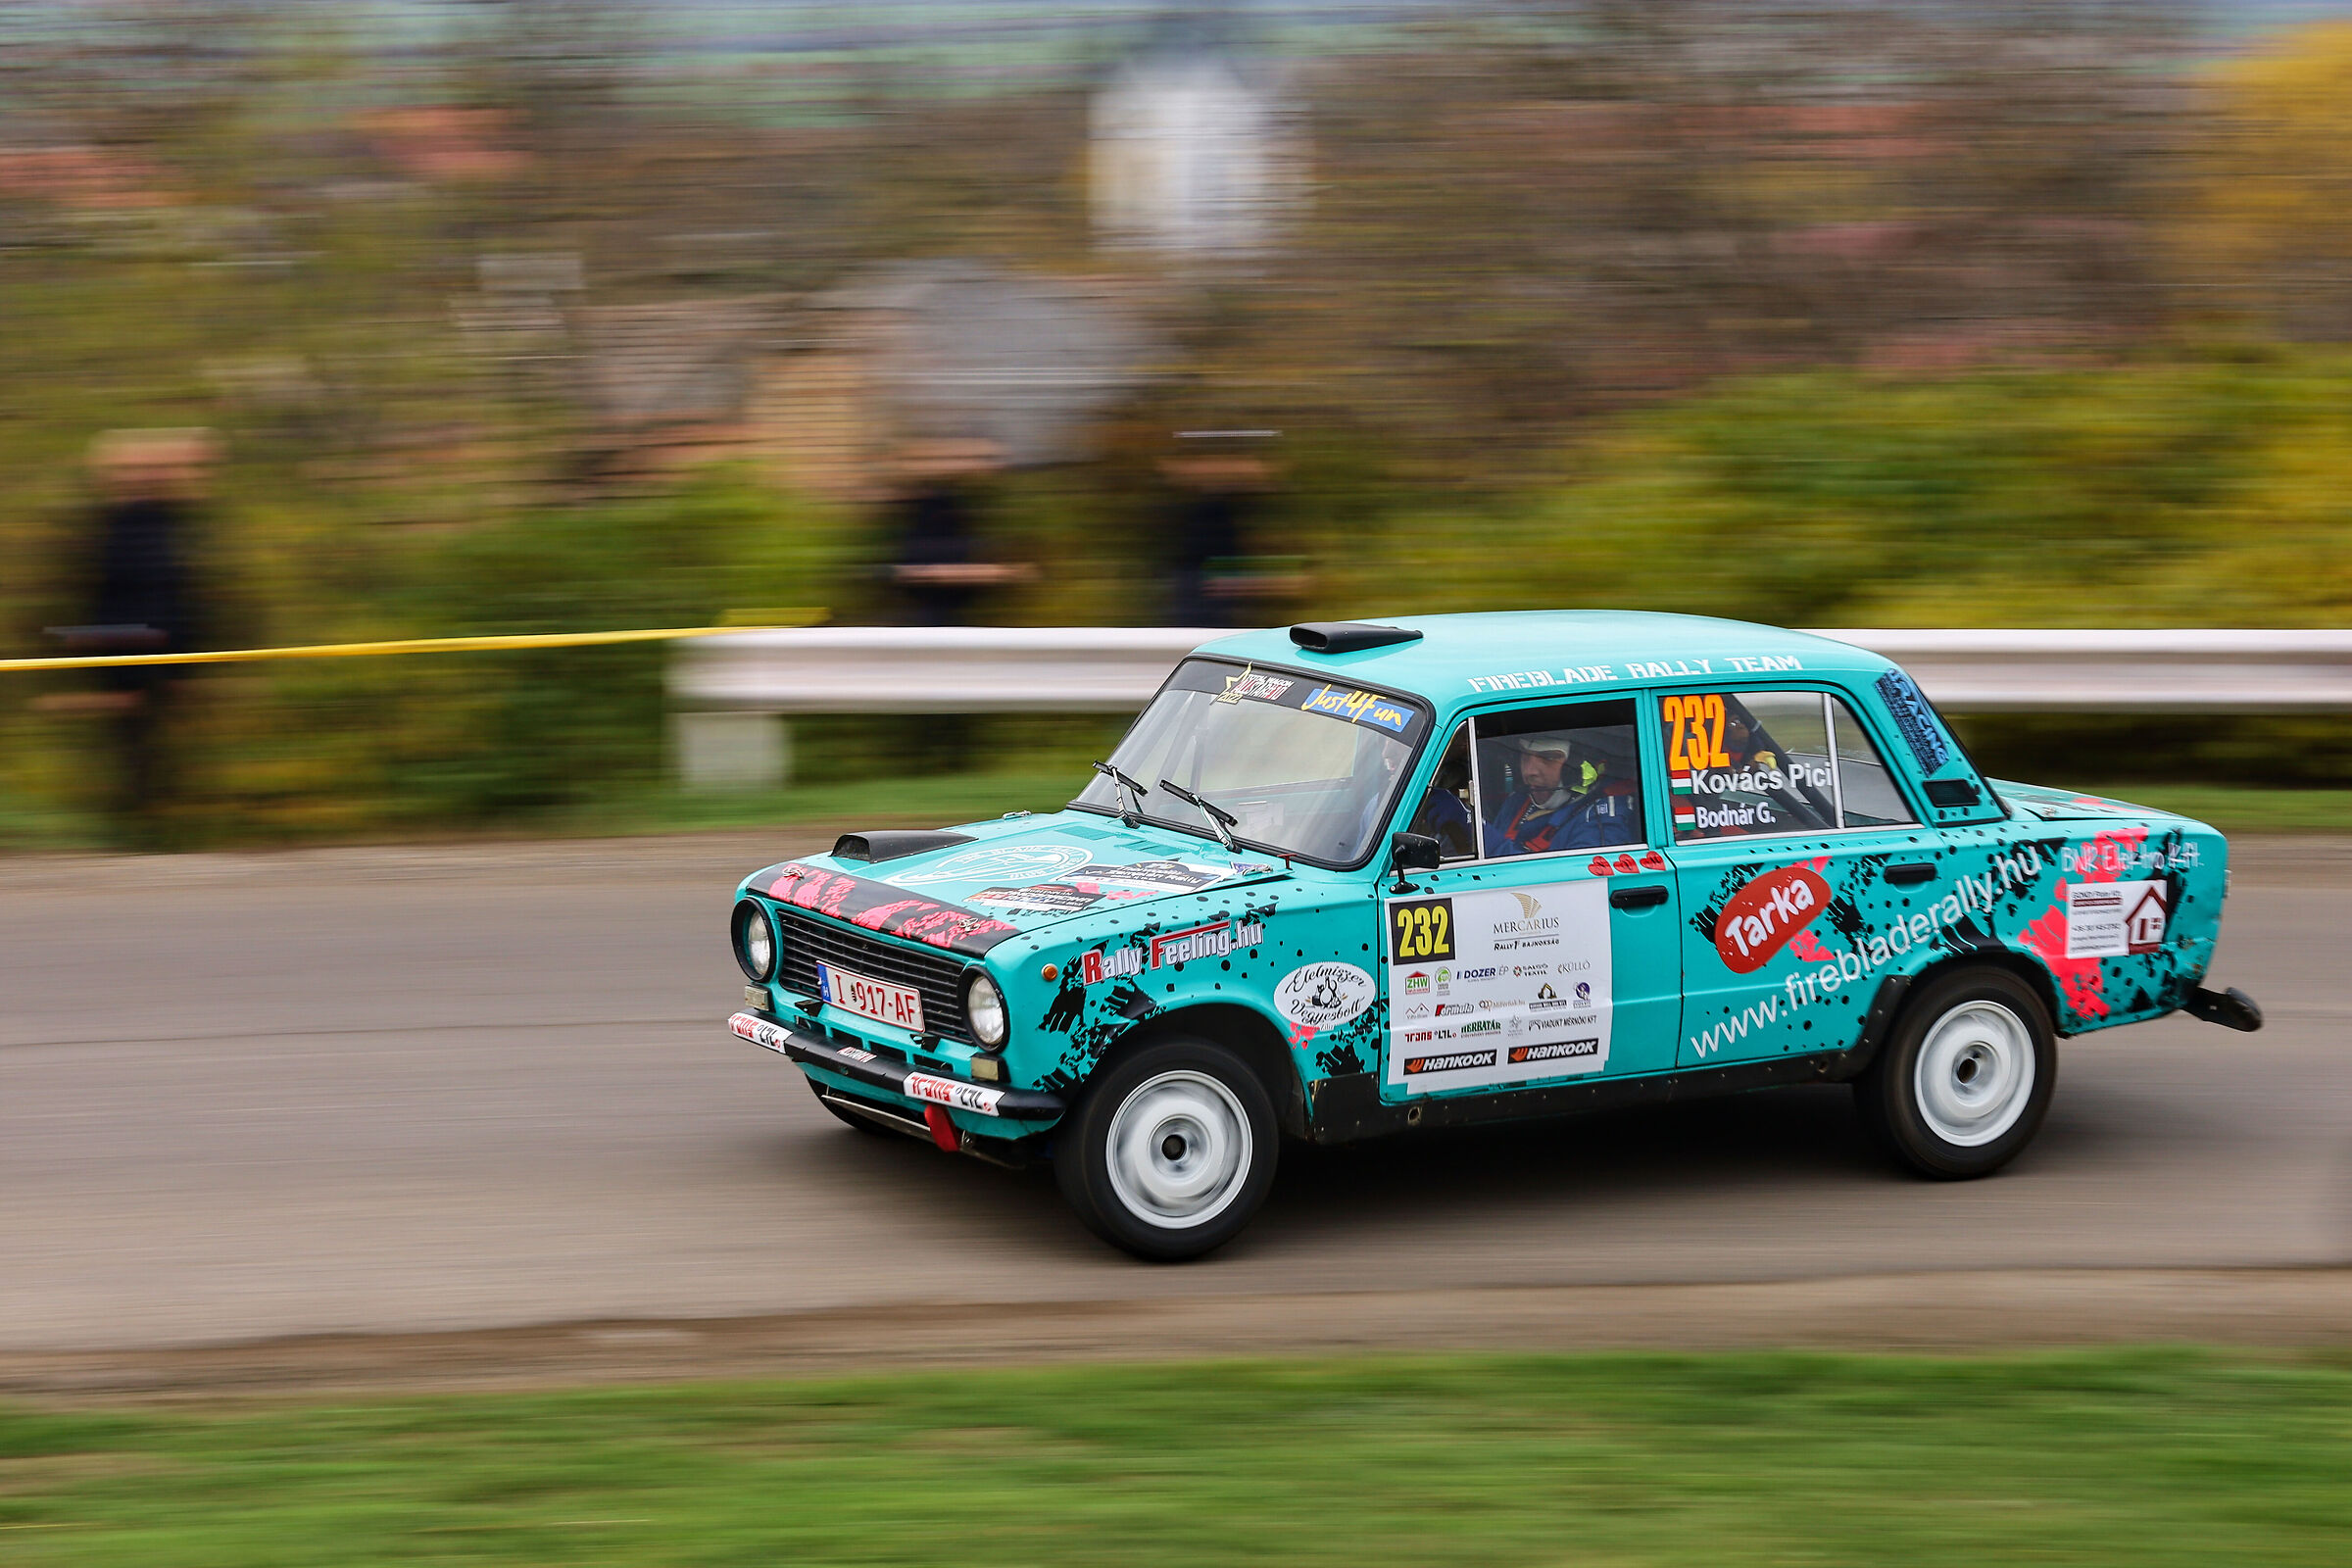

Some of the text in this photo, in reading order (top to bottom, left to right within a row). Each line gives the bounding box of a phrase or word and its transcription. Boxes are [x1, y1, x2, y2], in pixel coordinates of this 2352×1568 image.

[1467, 656, 1803, 693] FIREBLADE RALLY TEAM
[1663, 694, 1731, 771] 232
[1690, 761, 1833, 795] Kovács Pici
[1695, 801, 1777, 829] Bodnár G.
[1396, 906, 1449, 957] 232
[1494, 916, 1559, 934] MERCARIUS
[1725, 878, 1815, 957] Tarka
[1082, 919, 1265, 986] Rally Feeling.hu
[1690, 846, 2042, 1059] www.firebladerally.hu
[1407, 978, 1428, 989] ZHW
[1464, 967, 1496, 979] DOZER
[1461, 1019, 1501, 1034] HERBATÁR
